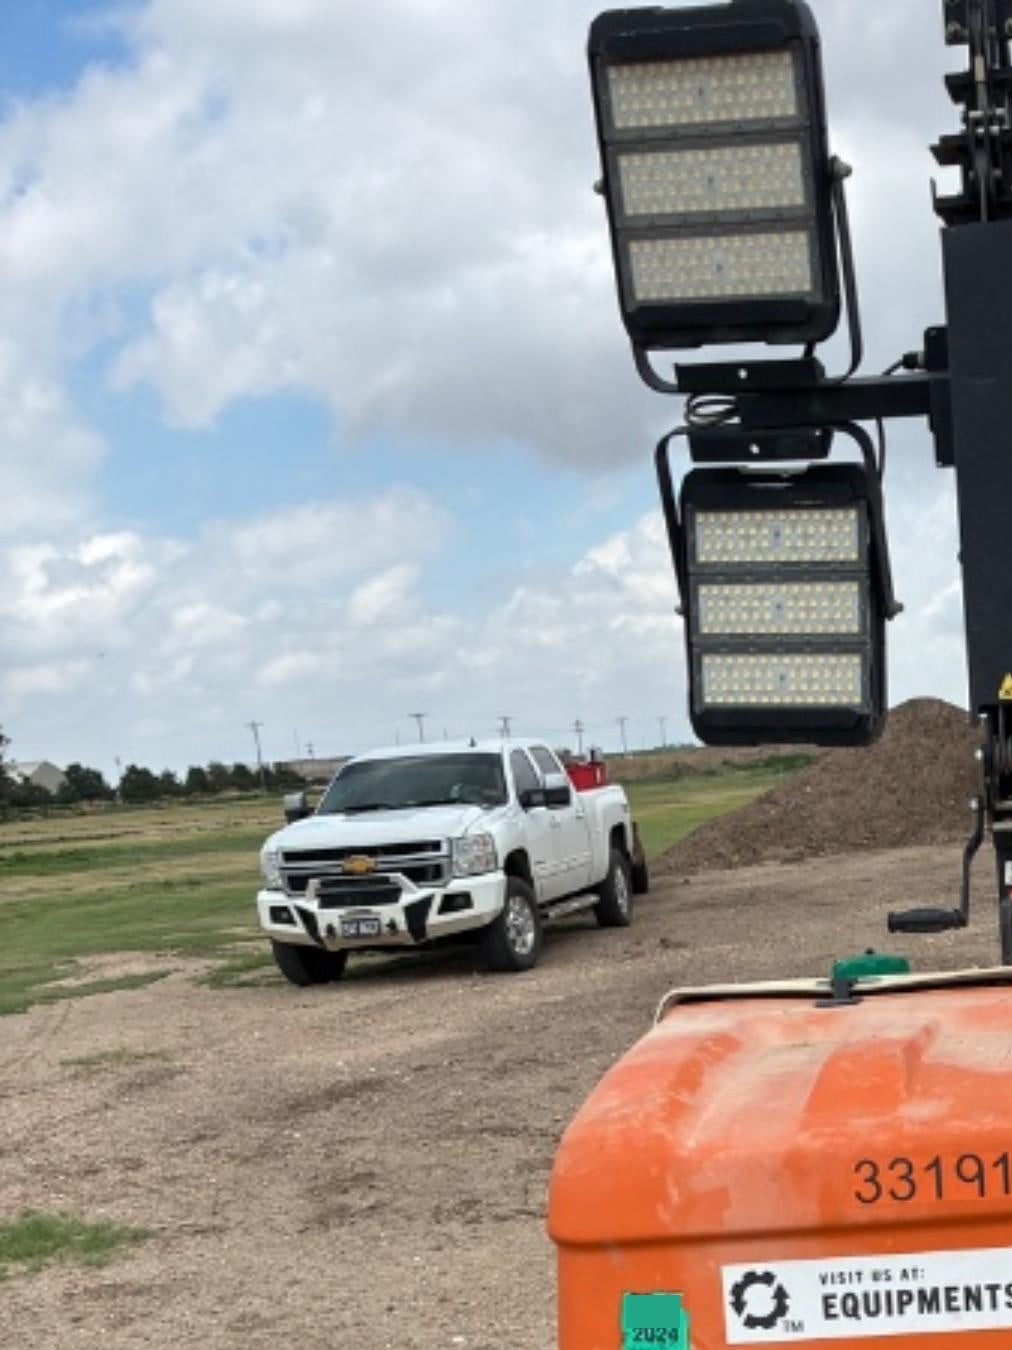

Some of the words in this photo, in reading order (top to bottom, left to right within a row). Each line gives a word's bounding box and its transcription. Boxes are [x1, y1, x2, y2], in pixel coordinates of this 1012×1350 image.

[818, 1270, 864, 1285] VISIT
[871, 1268, 892, 1282] US
[899, 1267, 926, 1281] AT:
